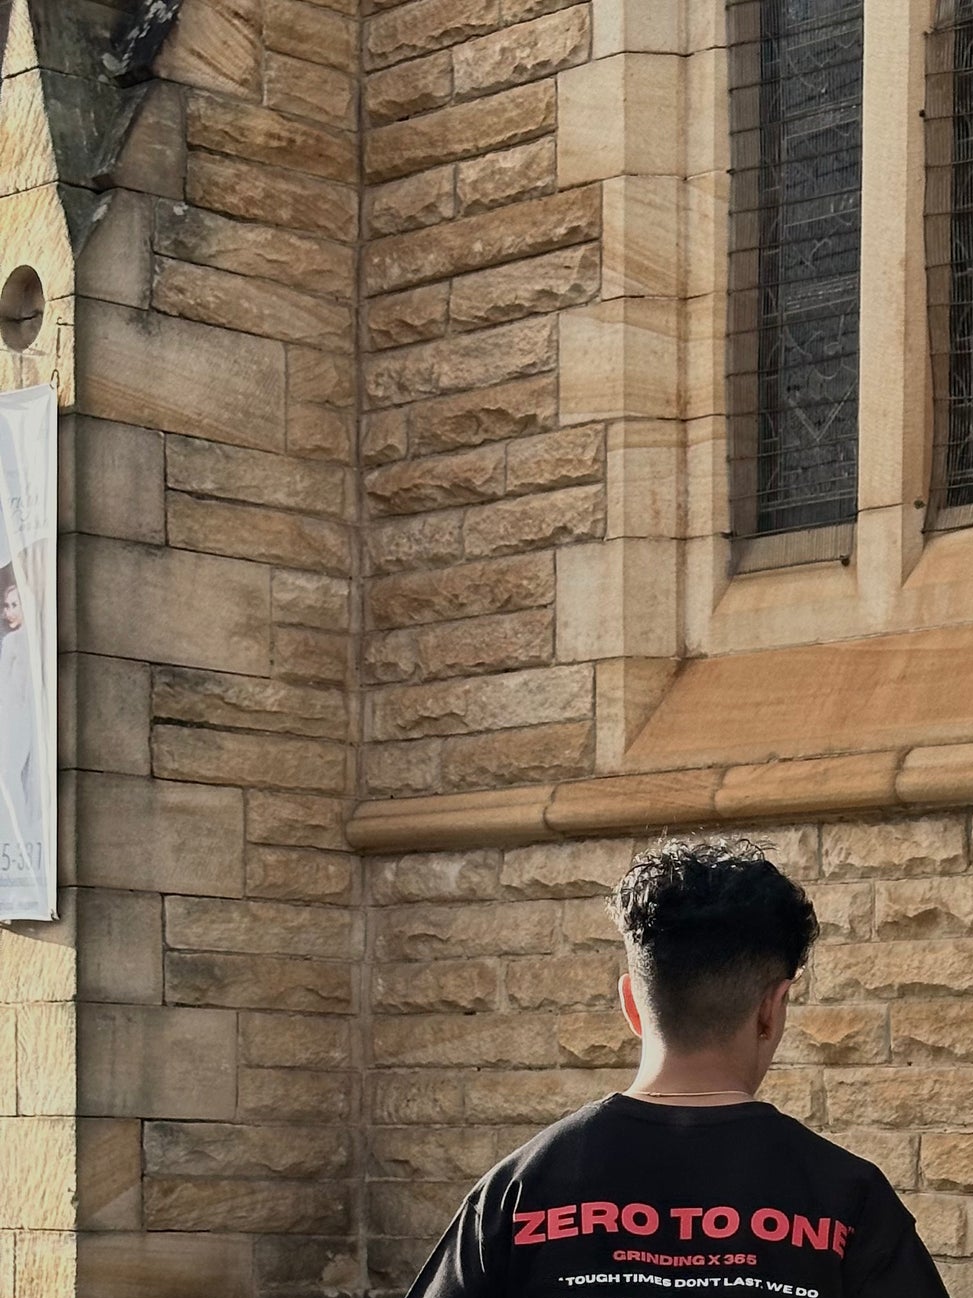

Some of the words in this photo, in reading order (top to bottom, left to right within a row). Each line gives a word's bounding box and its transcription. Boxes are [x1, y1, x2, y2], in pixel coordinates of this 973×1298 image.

[513, 1201, 660, 1245] ZERO
[670, 1206, 740, 1240] TO
[750, 1208, 848, 1259] ONE
[612, 1250, 705, 1267] GRINDING
[707, 1254, 721, 1265] X
[724, 1253, 757, 1266] 365
[564, 1273, 621, 1287] TOUGH
[622, 1273, 672, 1288] TIMES
[766, 1281, 793, 1295] WE
[795, 1287, 819, 1298] DO
